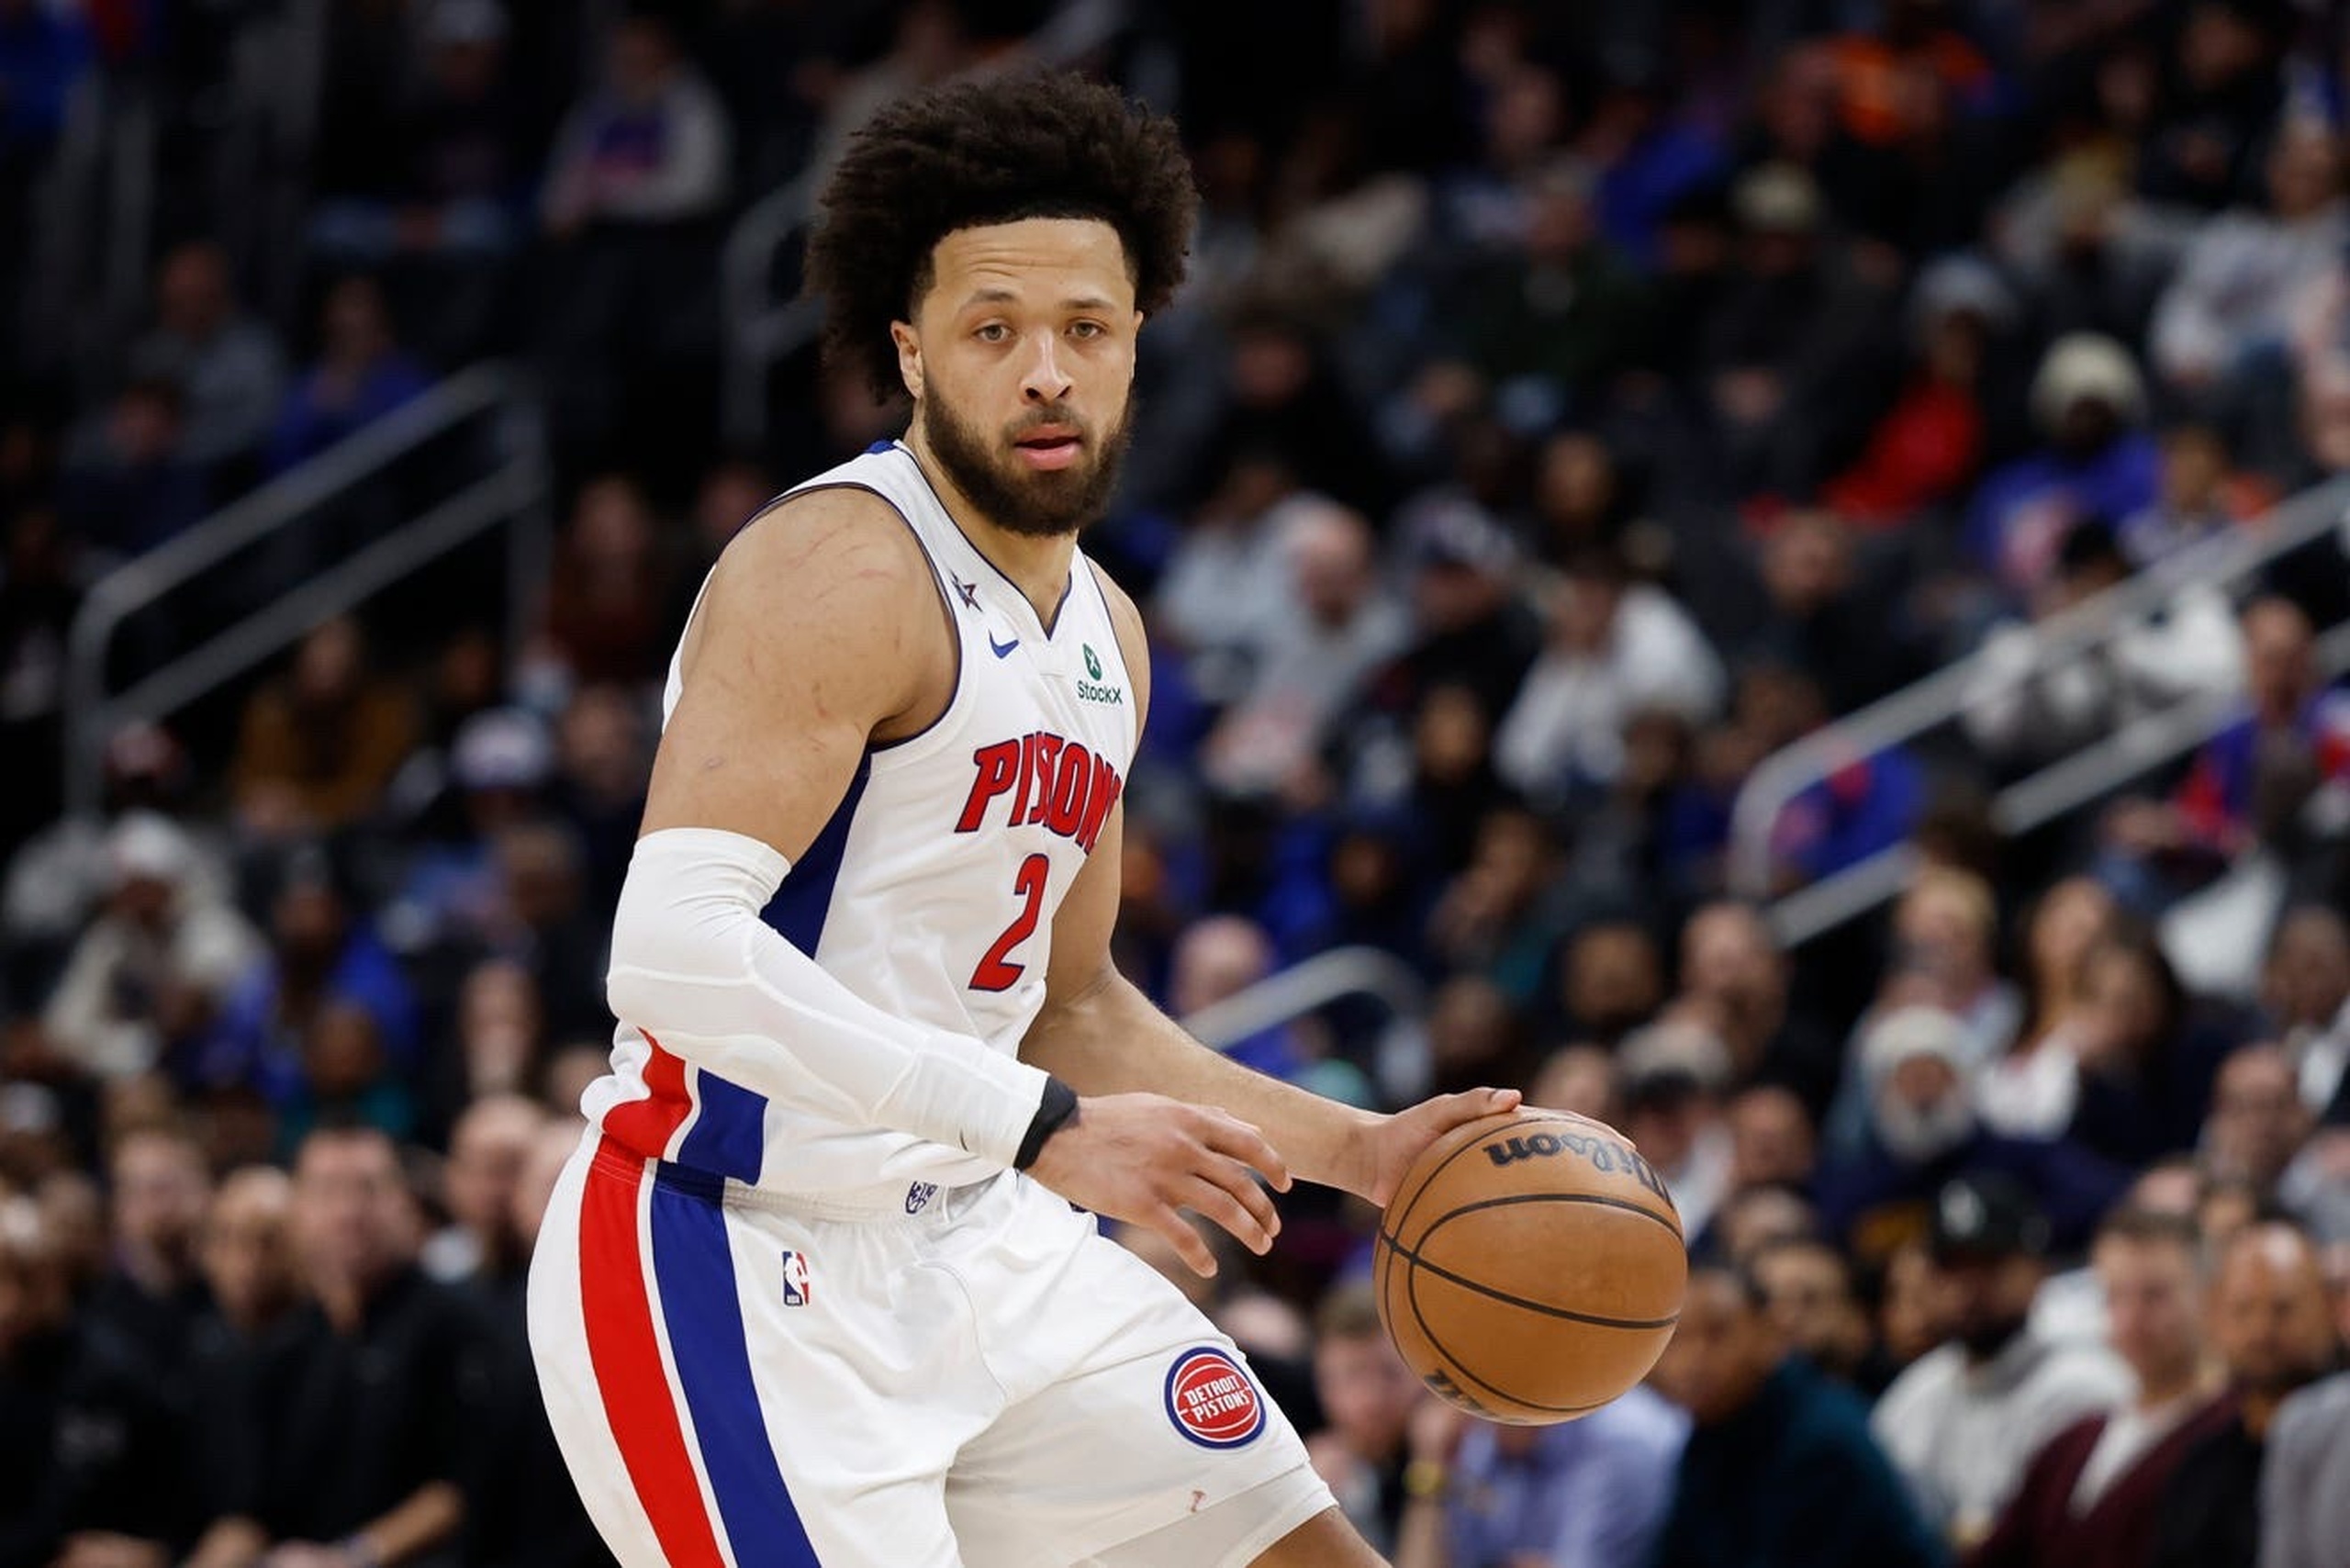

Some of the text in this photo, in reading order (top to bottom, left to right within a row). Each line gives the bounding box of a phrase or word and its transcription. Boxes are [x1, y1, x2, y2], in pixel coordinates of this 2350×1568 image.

[954, 732, 1122, 856] PISTON
[968, 853, 1049, 991] 2
[1183, 1374, 1240, 1406] DETROIT
[1191, 1390, 1250, 1423] PISTONS
